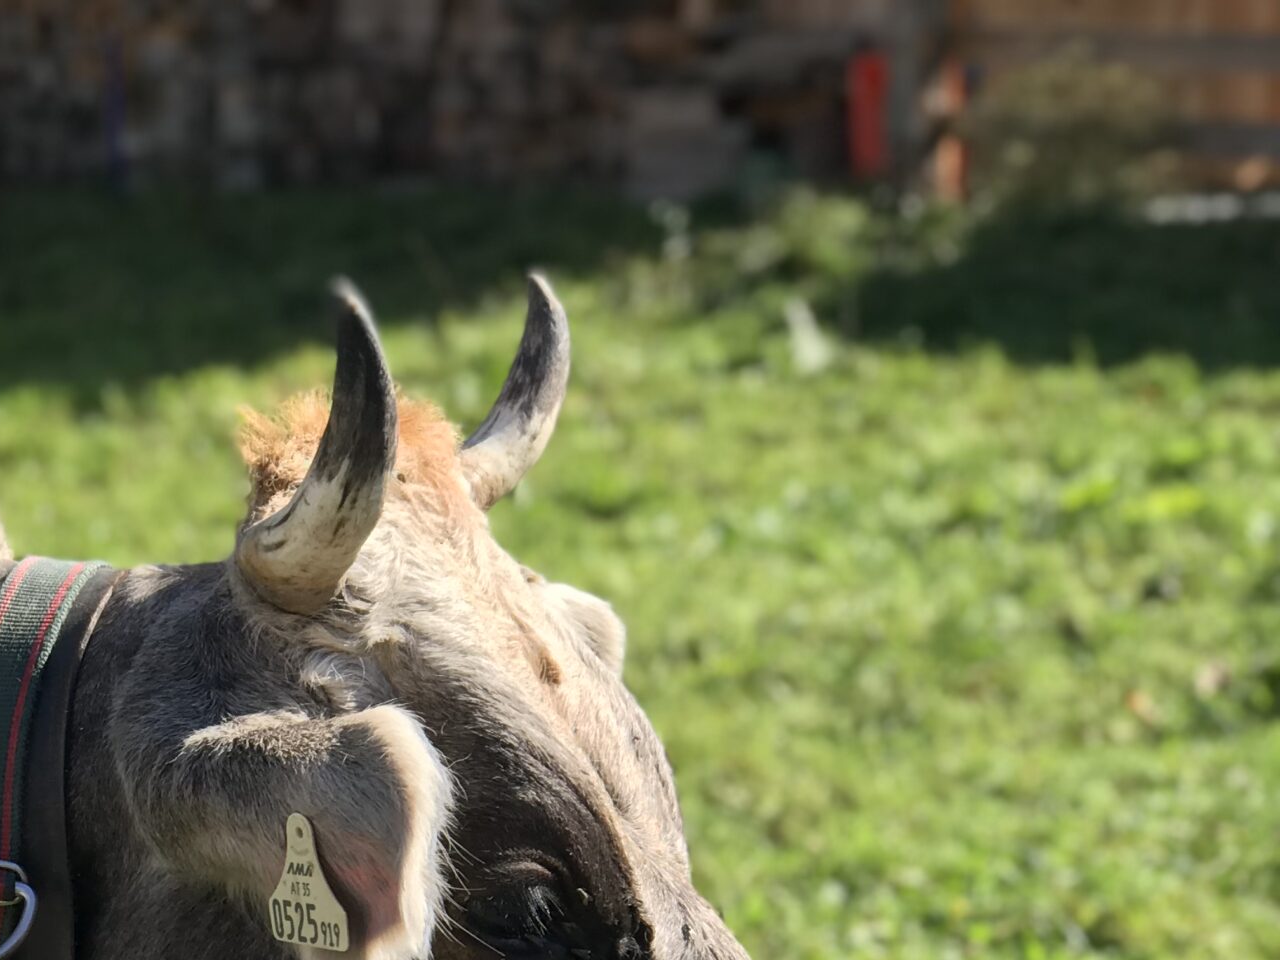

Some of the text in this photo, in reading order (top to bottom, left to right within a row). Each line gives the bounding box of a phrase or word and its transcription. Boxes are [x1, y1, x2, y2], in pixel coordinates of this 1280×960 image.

[291, 882, 300, 896] AT
[272, 899, 340, 947] 0525 919
